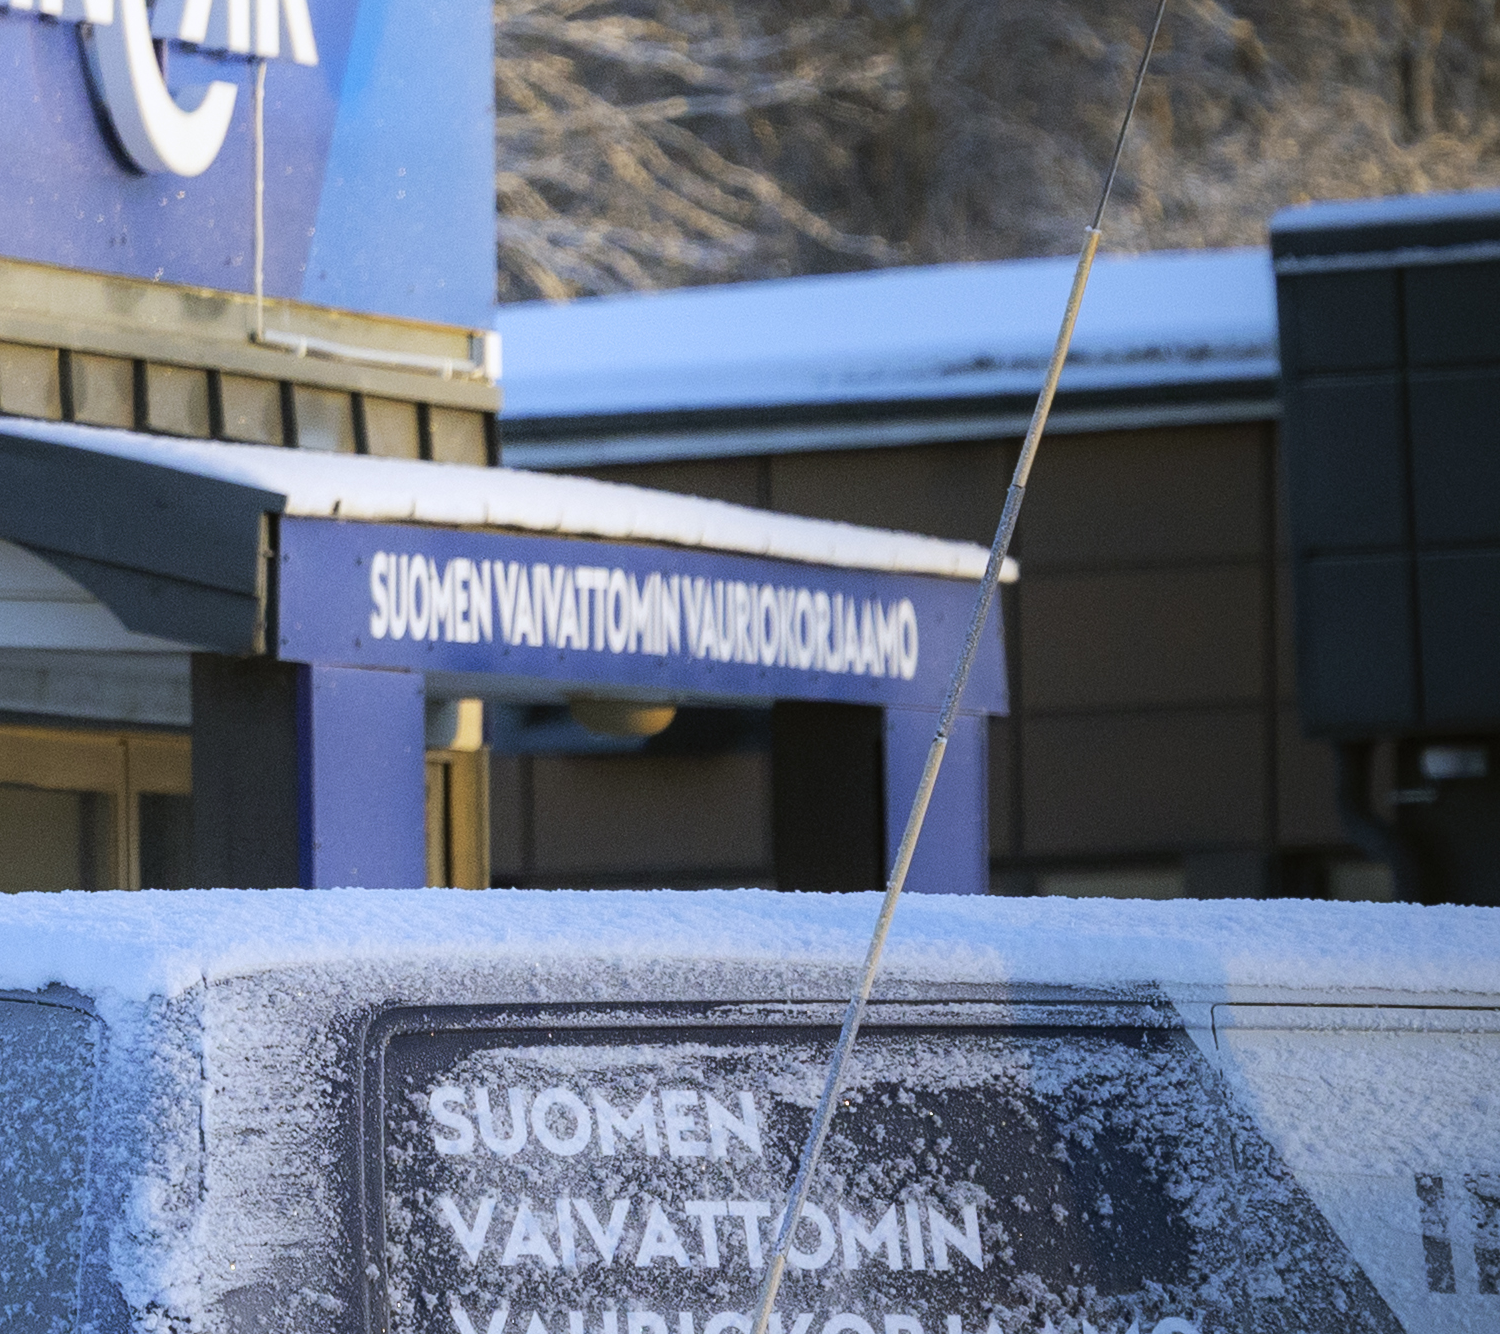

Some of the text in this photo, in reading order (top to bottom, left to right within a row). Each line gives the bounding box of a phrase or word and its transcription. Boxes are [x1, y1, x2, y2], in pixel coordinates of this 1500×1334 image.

[370, 551, 919, 681] SUOMEN VAIVATTOMIN VAURIOKORJAAMO
[429, 1085, 763, 1159] SUOMEN
[438, 1195, 985, 1272] VAIVATTOMIN
